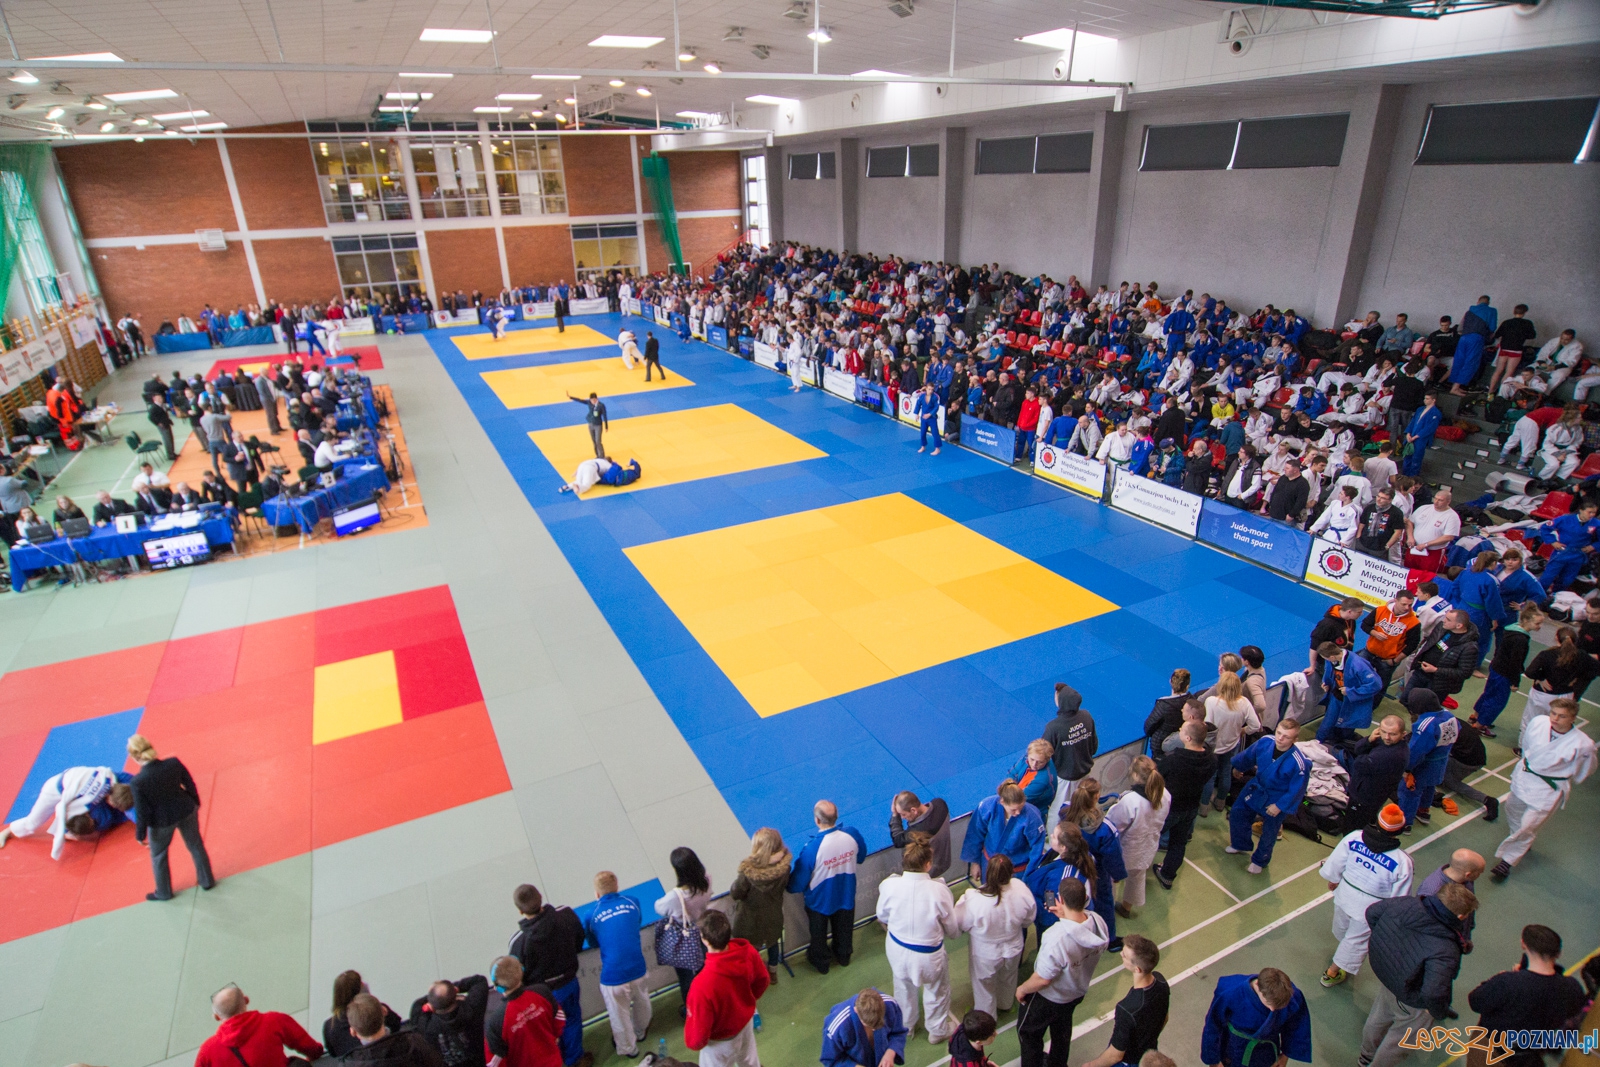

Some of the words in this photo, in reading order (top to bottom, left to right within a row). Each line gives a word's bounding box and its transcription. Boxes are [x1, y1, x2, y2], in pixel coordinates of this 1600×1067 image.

[1230, 521, 1269, 539] Judo-more
[1233, 532, 1250, 543] than
[1250, 538, 1274, 550] sport!
[1364, 559, 1408, 579] Wielkopol
[1359, 580, 1388, 597] Turniej
[1360, 569, 1407, 590] Międzynar
[1068, 722, 1084, 733] JUDO
[1355, 856, 1377, 874] POL
